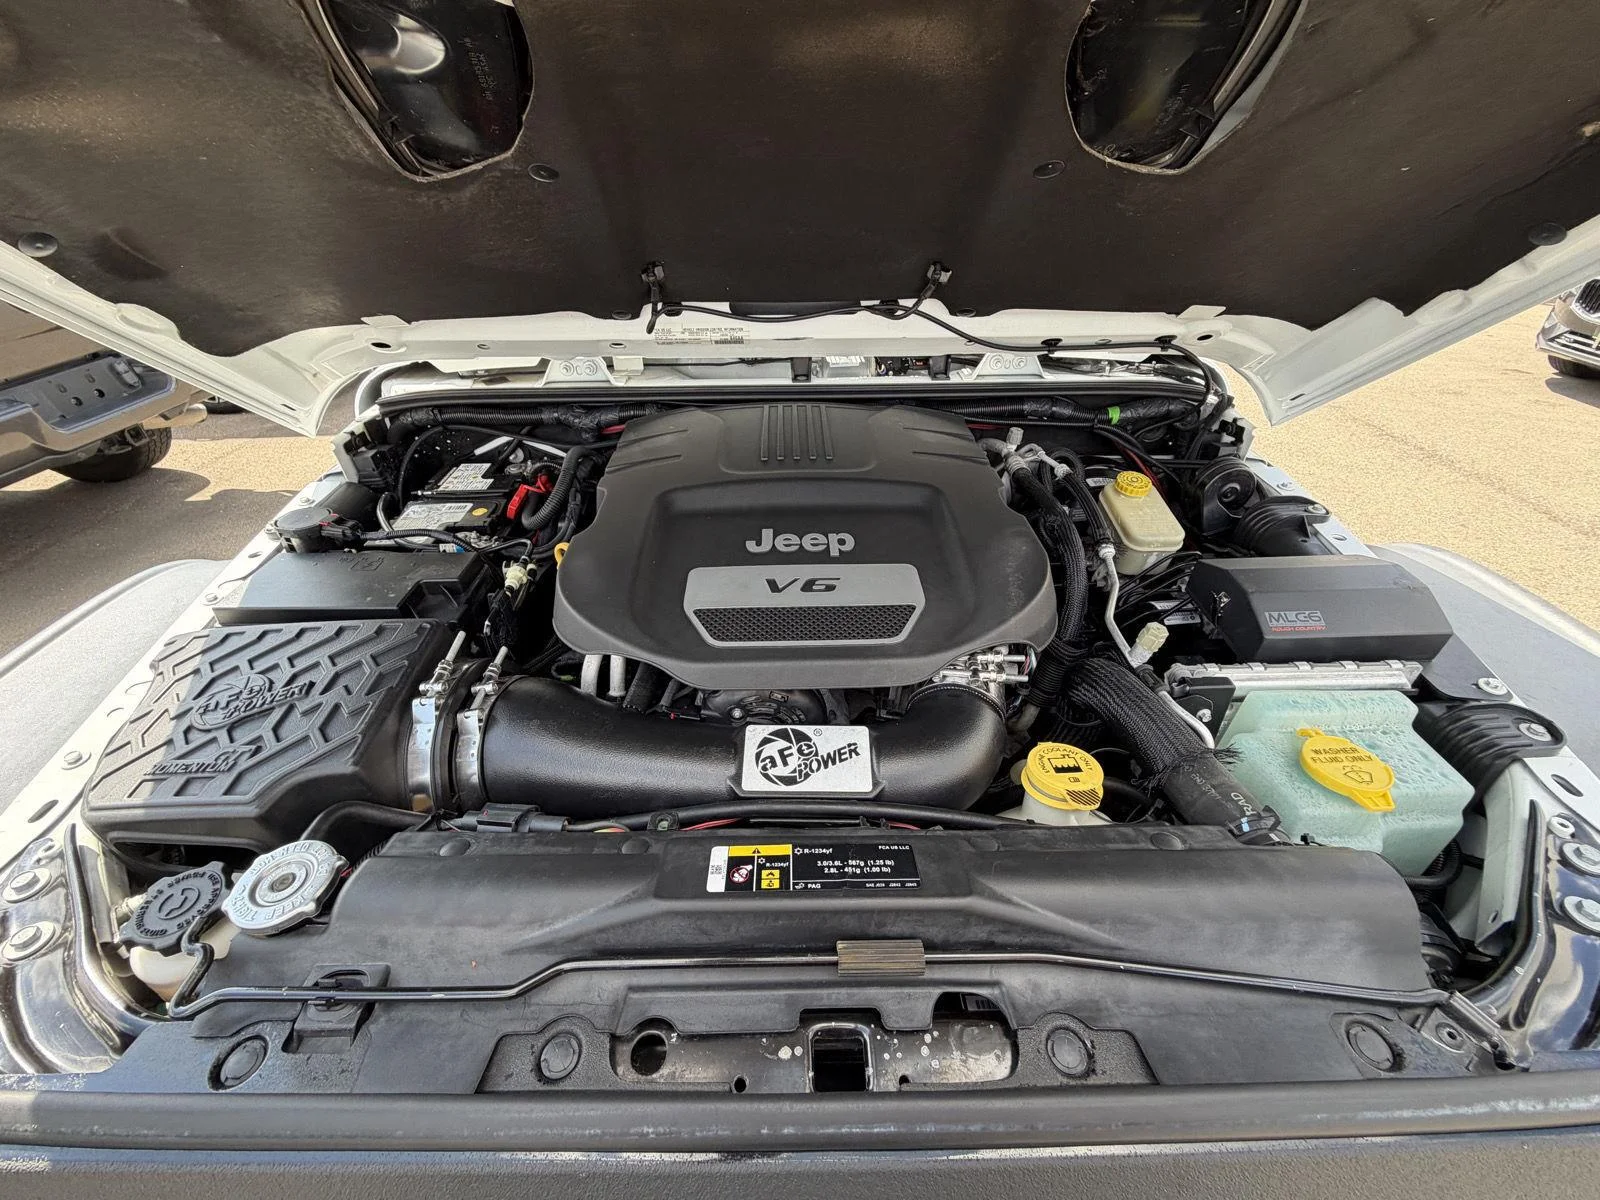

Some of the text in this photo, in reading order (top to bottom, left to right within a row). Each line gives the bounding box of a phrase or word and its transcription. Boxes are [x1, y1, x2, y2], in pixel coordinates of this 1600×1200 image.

[745, 528, 855, 557] Jeep
[765, 577, 841, 594] V6
[760, 742, 816, 773] aFe
[797, 742, 861, 781] POWER
[1043, 747, 1079, 756] COOLANT
[1080, 755, 1092, 770] ONLY
[1311, 747, 1360, 755] WASHER
[1311, 756, 1344, 764] FLUID
[144, 760, 239, 776] MOMENTUM
[1230, 792, 1258, 816] RAD
[207, 873, 220, 886] USE
[231, 895, 304, 922] KEEP TIGHT
